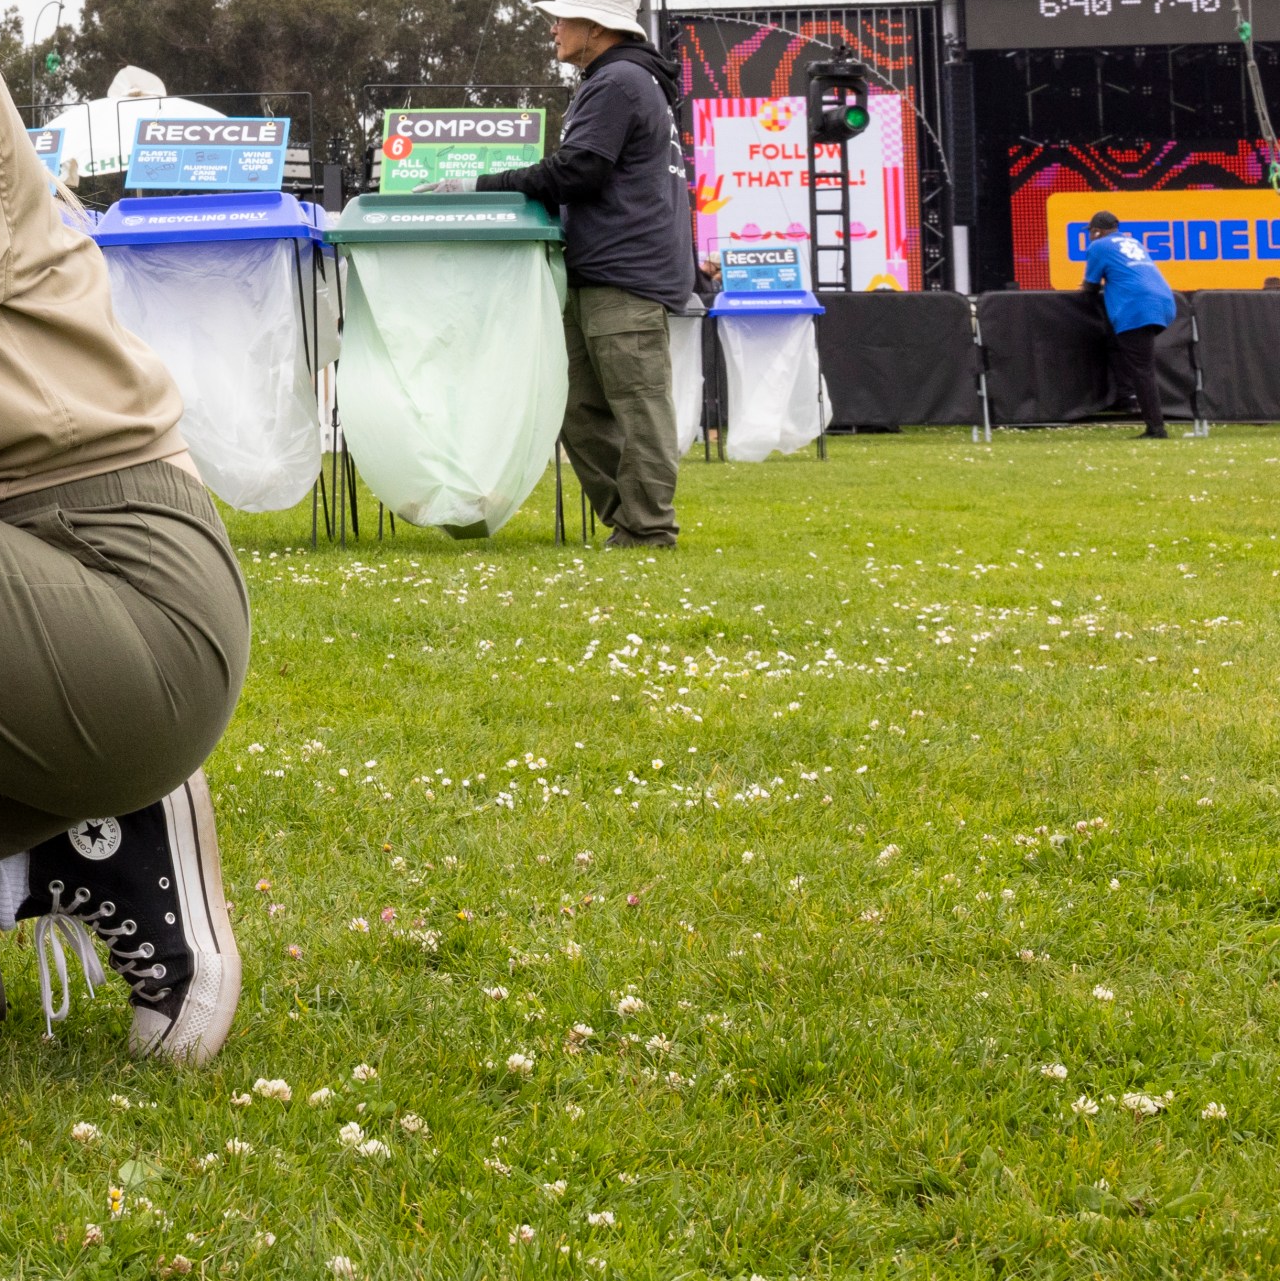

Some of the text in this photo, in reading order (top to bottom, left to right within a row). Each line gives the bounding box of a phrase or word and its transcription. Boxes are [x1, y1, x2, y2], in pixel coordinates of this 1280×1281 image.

[145, 125, 277, 142] RECYCLE
[396, 119, 533, 138] COMPOST
[392, 138, 404, 156] 6
[748, 143, 842, 160] FOLLOW
[85, 154, 132, 173] CHU
[398, 159, 424, 168] ALL
[439, 161, 485, 169] SERVICE
[391, 169, 429, 179] FOOD
[445, 169, 478, 177] ITEMS
[732, 169, 866, 187] THAT BALL!
[149, 213, 226, 224] RECYCLING
[230, 211, 267, 220] ONLY
[390, 213, 517, 222] COMPOSTABLES
[726, 251, 794, 265] RECYCLE
